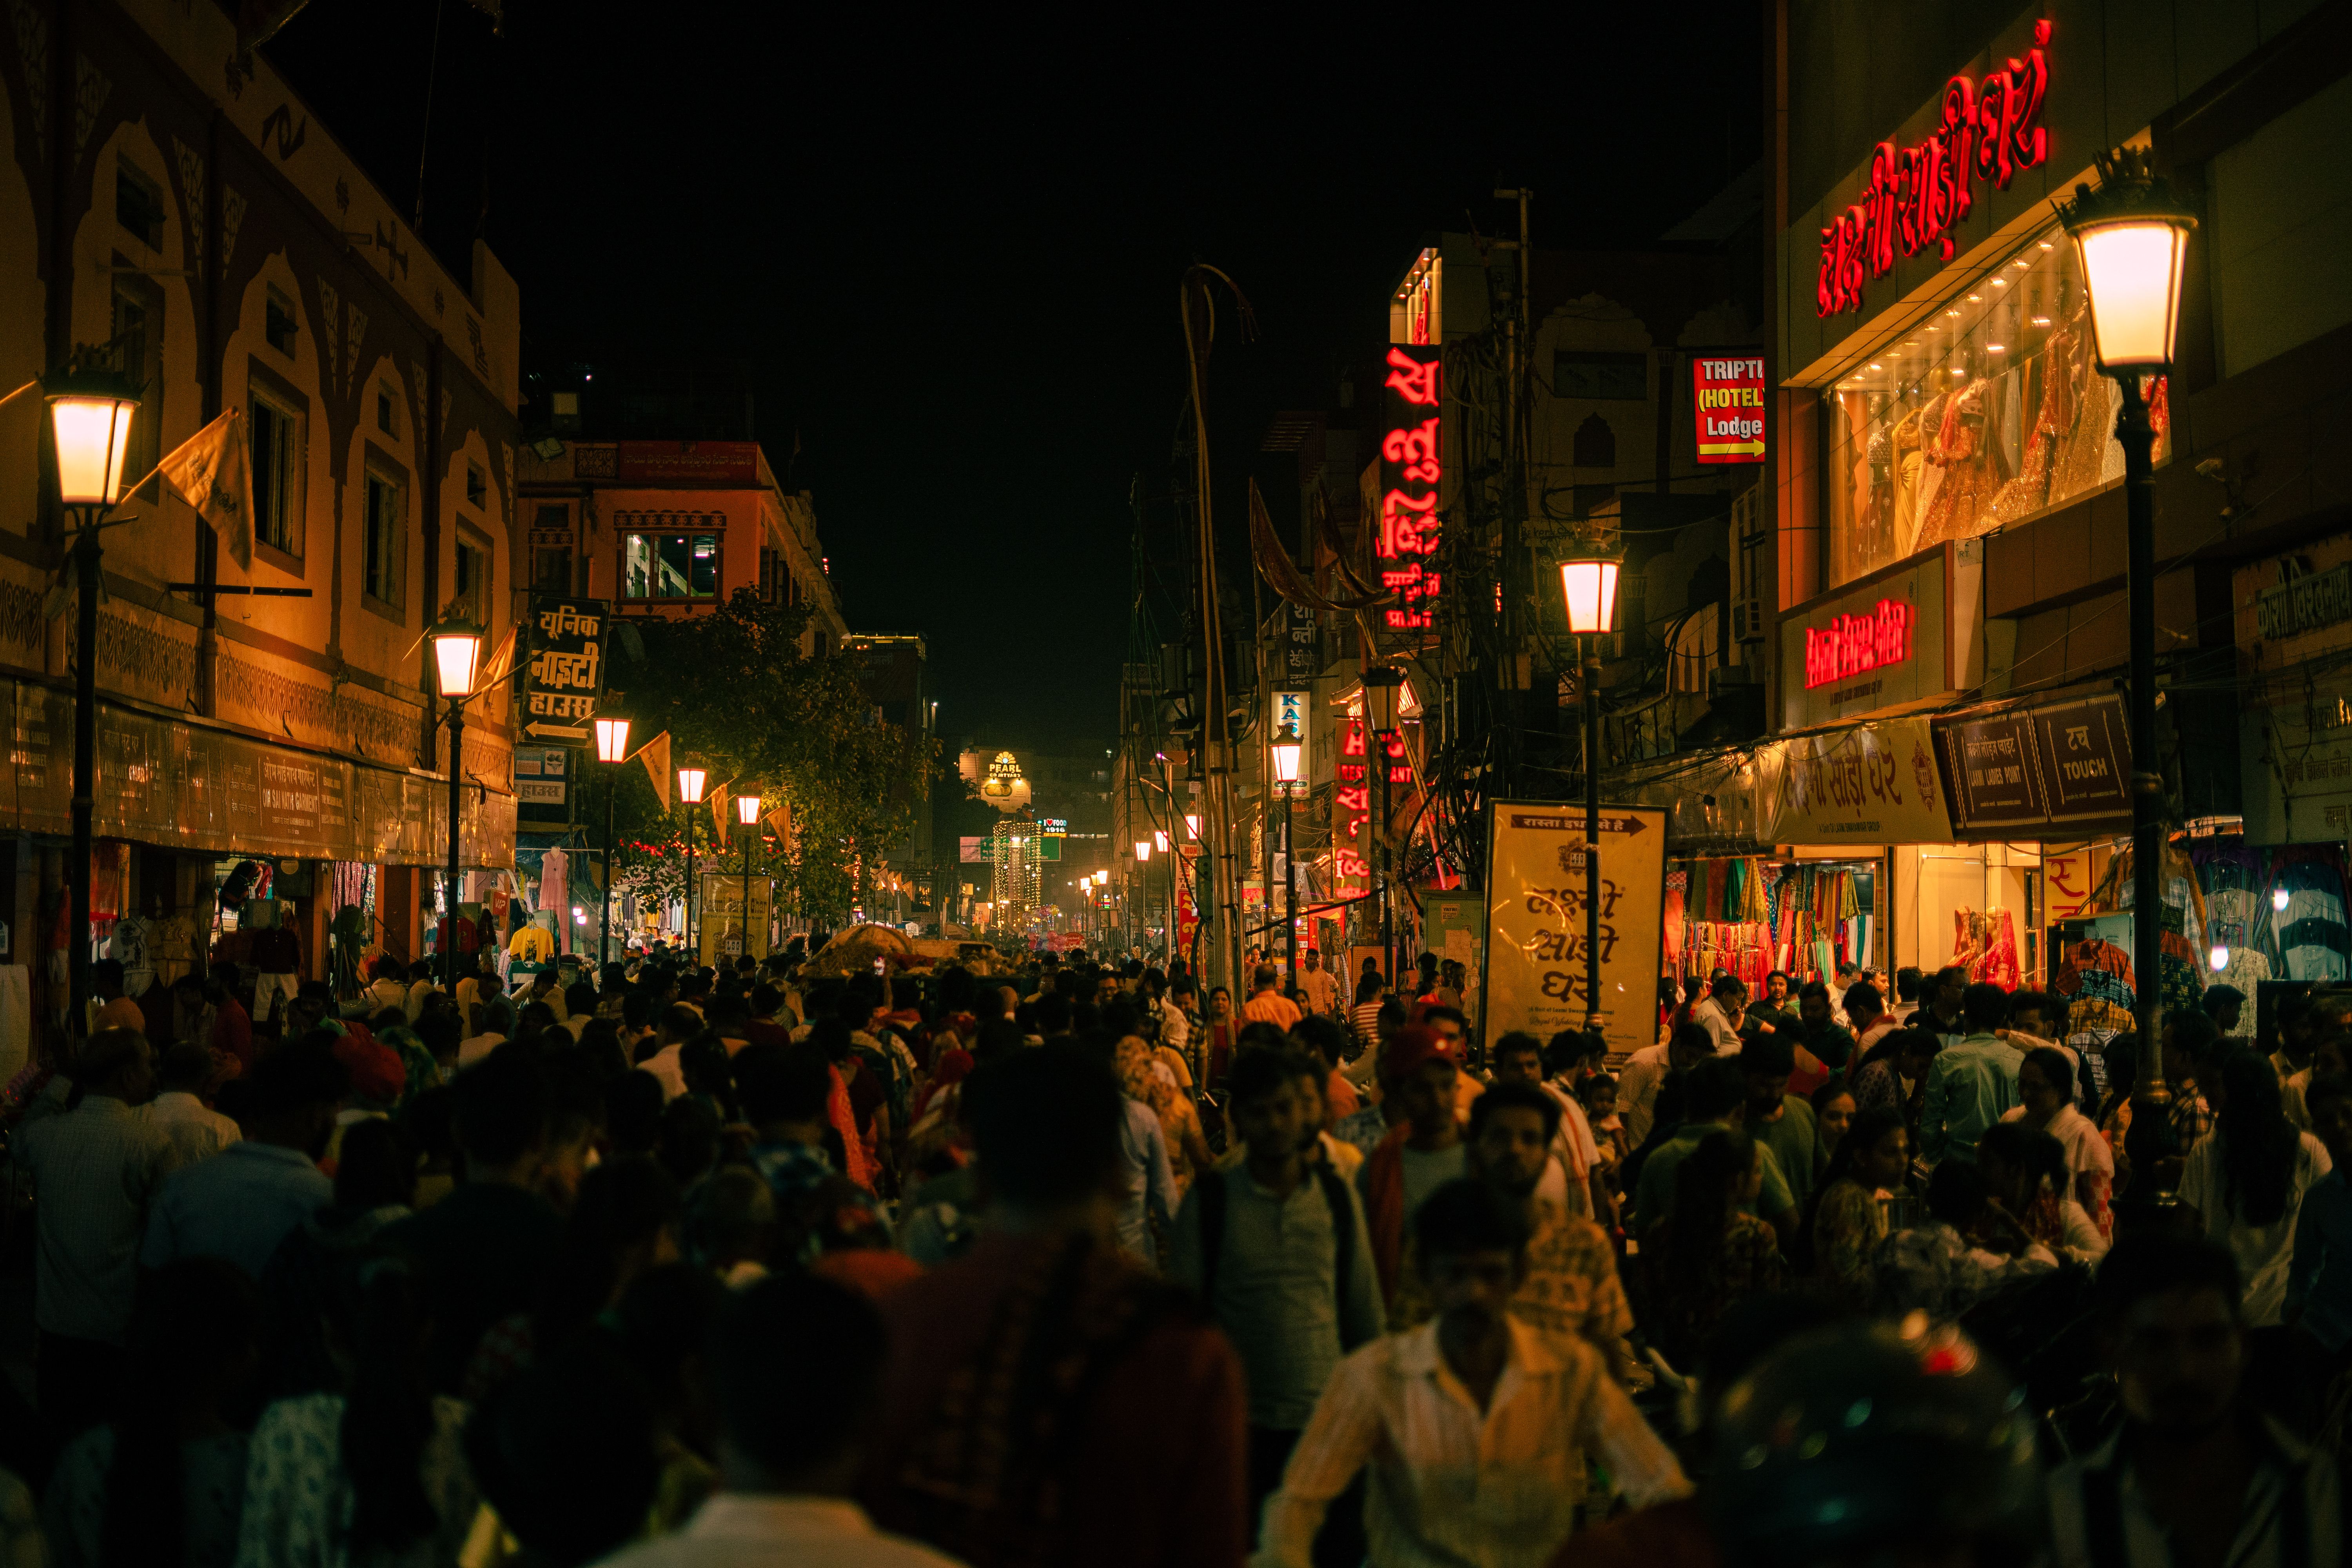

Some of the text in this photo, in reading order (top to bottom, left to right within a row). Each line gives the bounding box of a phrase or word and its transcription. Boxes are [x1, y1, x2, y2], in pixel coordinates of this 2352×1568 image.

[1702, 359, 1763, 380] TRIPTI
[1707, 416, 1762, 439] Lodge
[540, 604, 601, 641] यूनिक
[531, 641, 599, 690] नाइटी
[529, 690, 595, 719] हाउस
[2065, 725, 2092, 751] टच
[989, 764, 1022, 772] PEARL
[2004, 765, 2021, 784] POINT
[2063, 758, 2109, 780] TOUCH
[272, 789, 281, 809] SAI
[294, 791, 318, 813] GARMENT
[1524, 816, 1560, 828] रास्ता
[1564, 818, 1586, 829] इध
[495, 898, 506, 909] VIP
